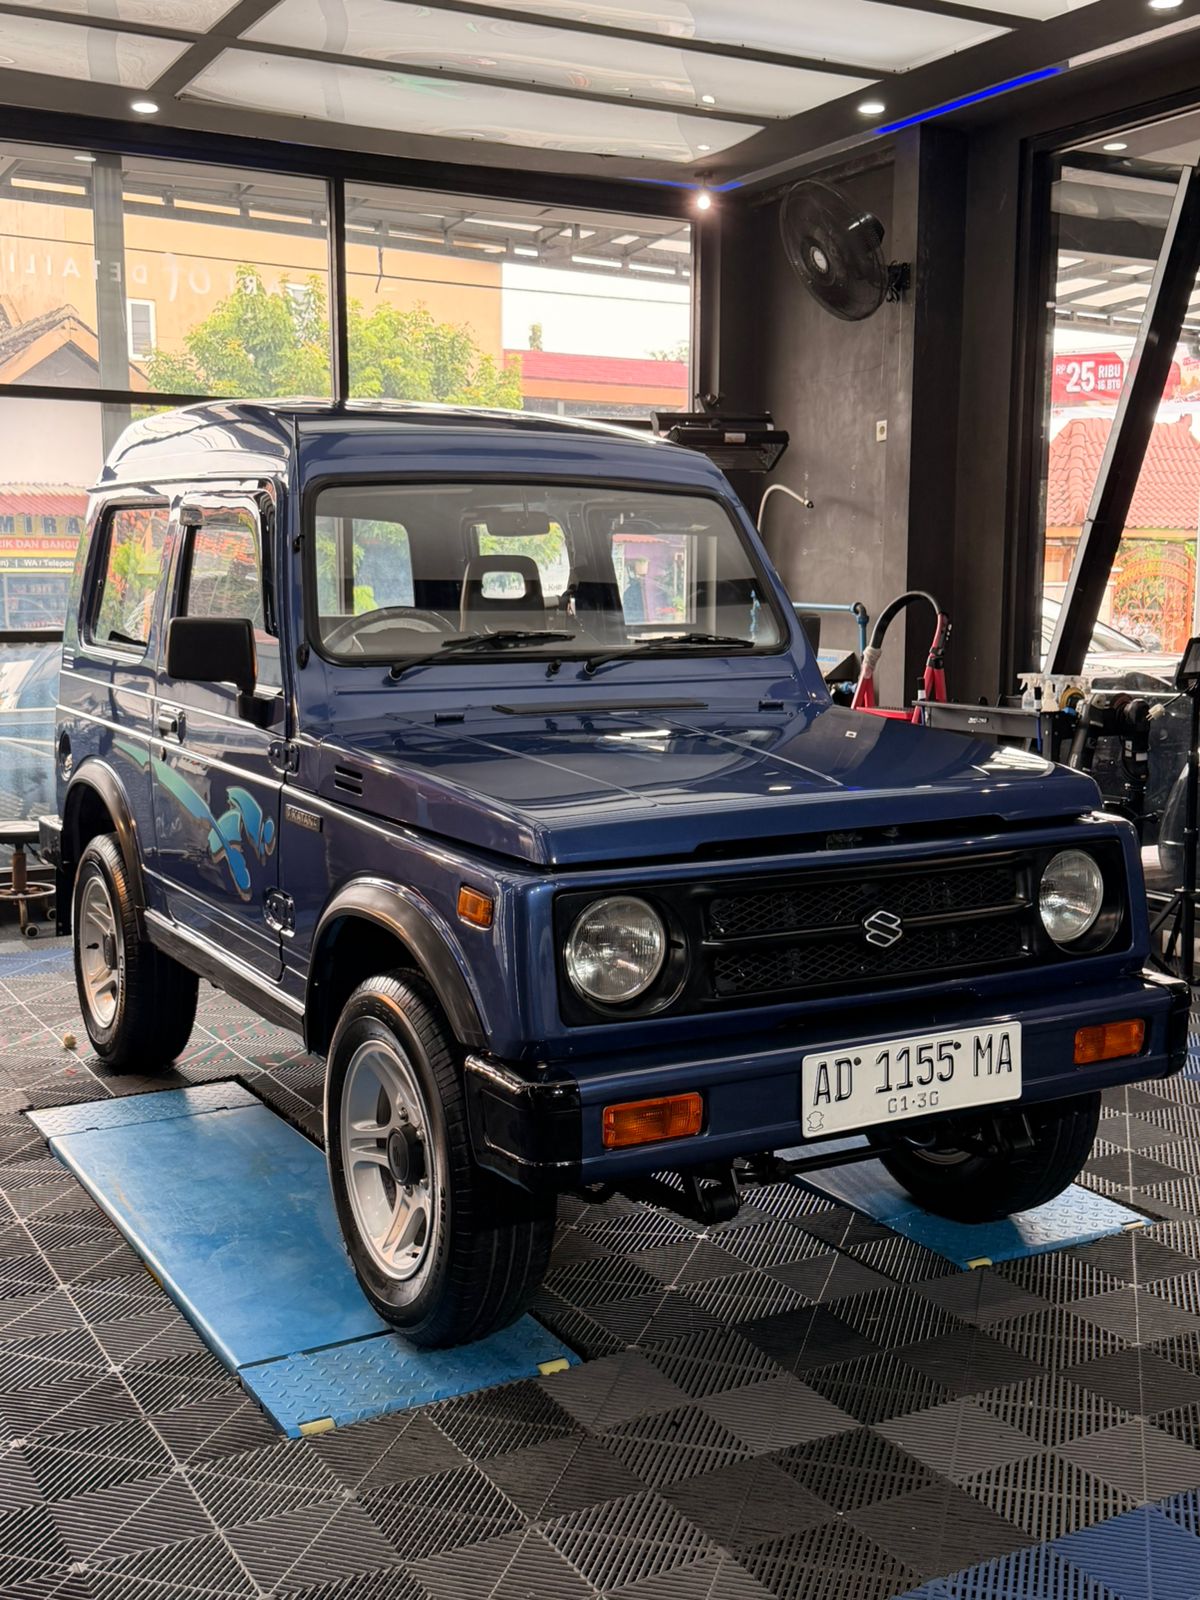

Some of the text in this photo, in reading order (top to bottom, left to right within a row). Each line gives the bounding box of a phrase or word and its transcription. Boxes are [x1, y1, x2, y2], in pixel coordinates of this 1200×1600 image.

[1066, 361, 1095, 393] 25
[1097, 364, 1121, 379] RIBU
[16, 540, 40, 550] DAN
[812, 1031, 1013, 1107] AD 1155 MA
